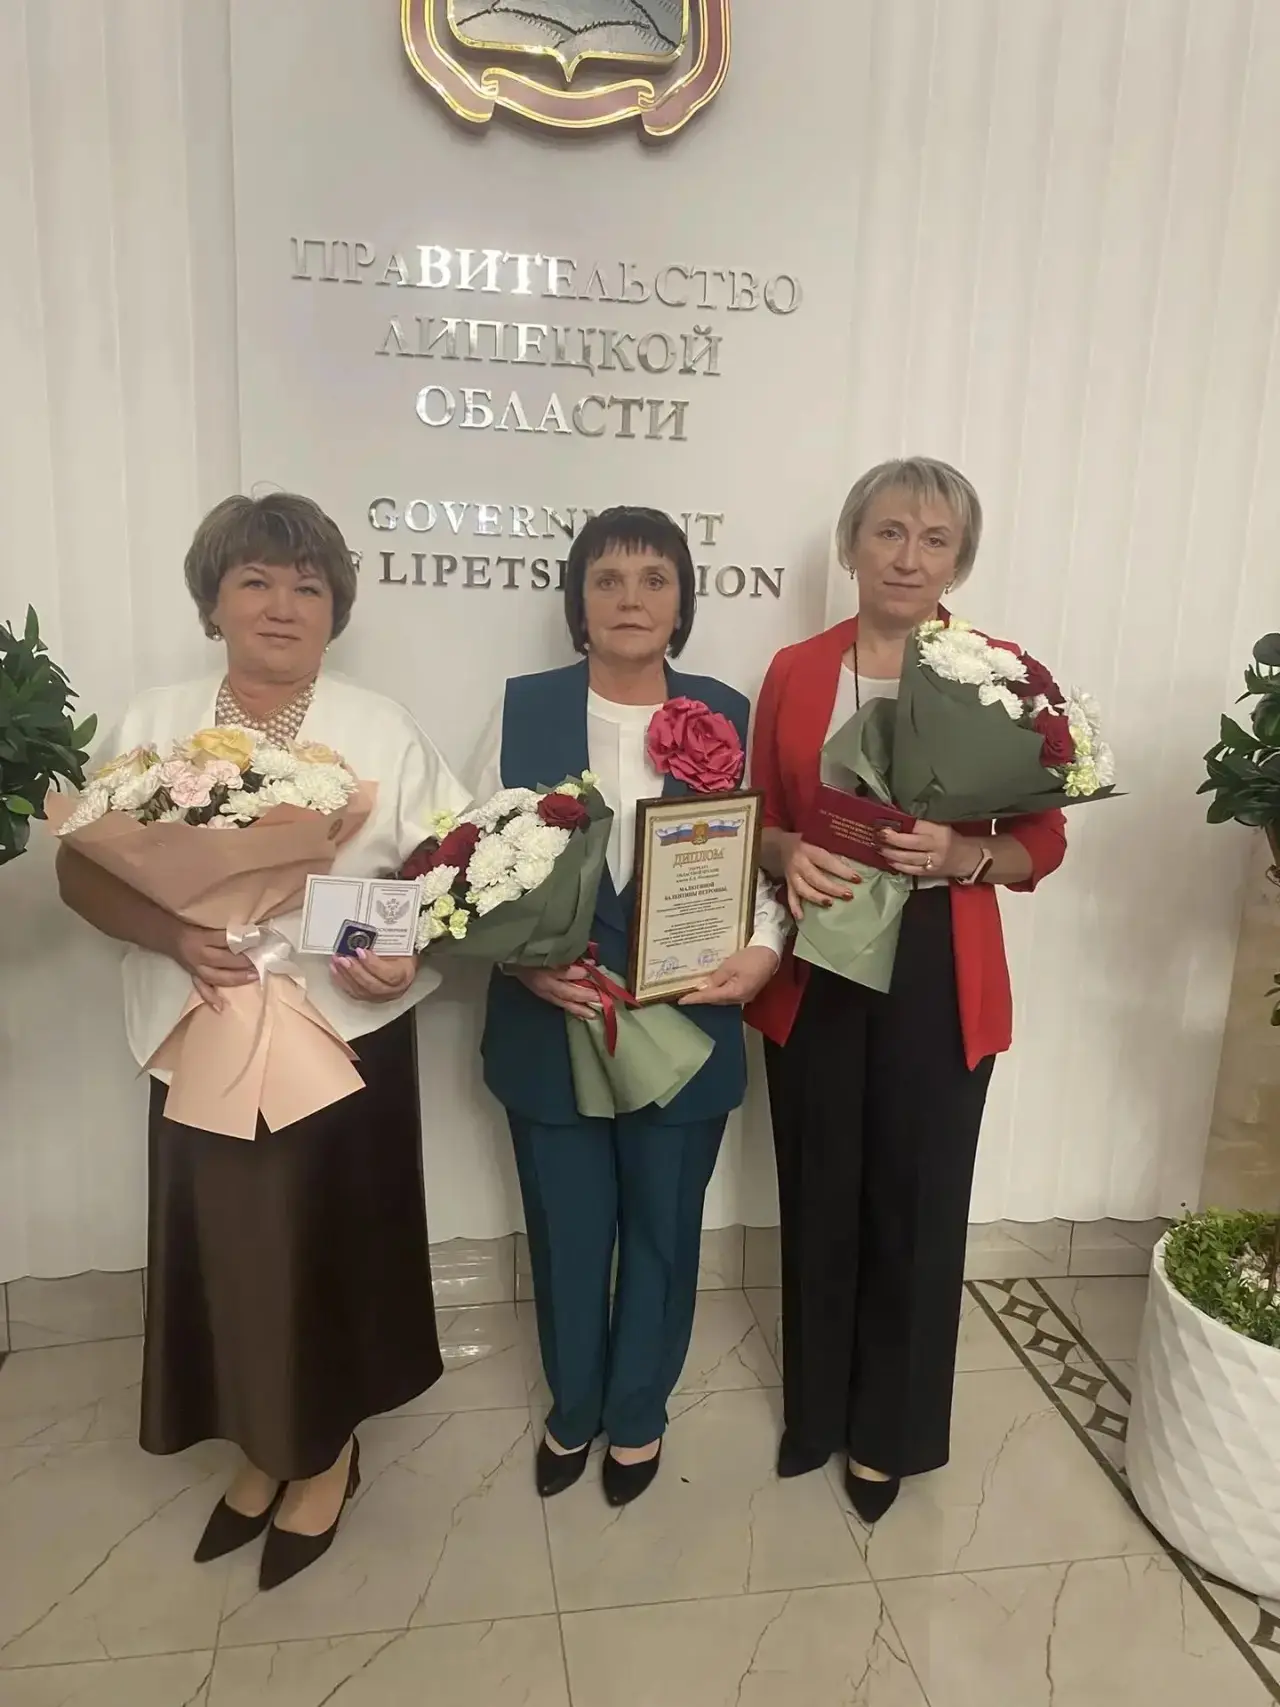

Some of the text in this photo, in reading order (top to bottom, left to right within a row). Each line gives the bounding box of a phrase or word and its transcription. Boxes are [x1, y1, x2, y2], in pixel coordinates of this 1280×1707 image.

[290, 236, 804, 316] ПРАВИТЕЛЬСТВО
[374, 315, 723, 377] ЛИПЕЦКОЙ
[415, 384, 690, 442] ОБЛАСТИ
[368, 496, 725, 546] GOVERNT
[695, 564, 785, 599] ION
